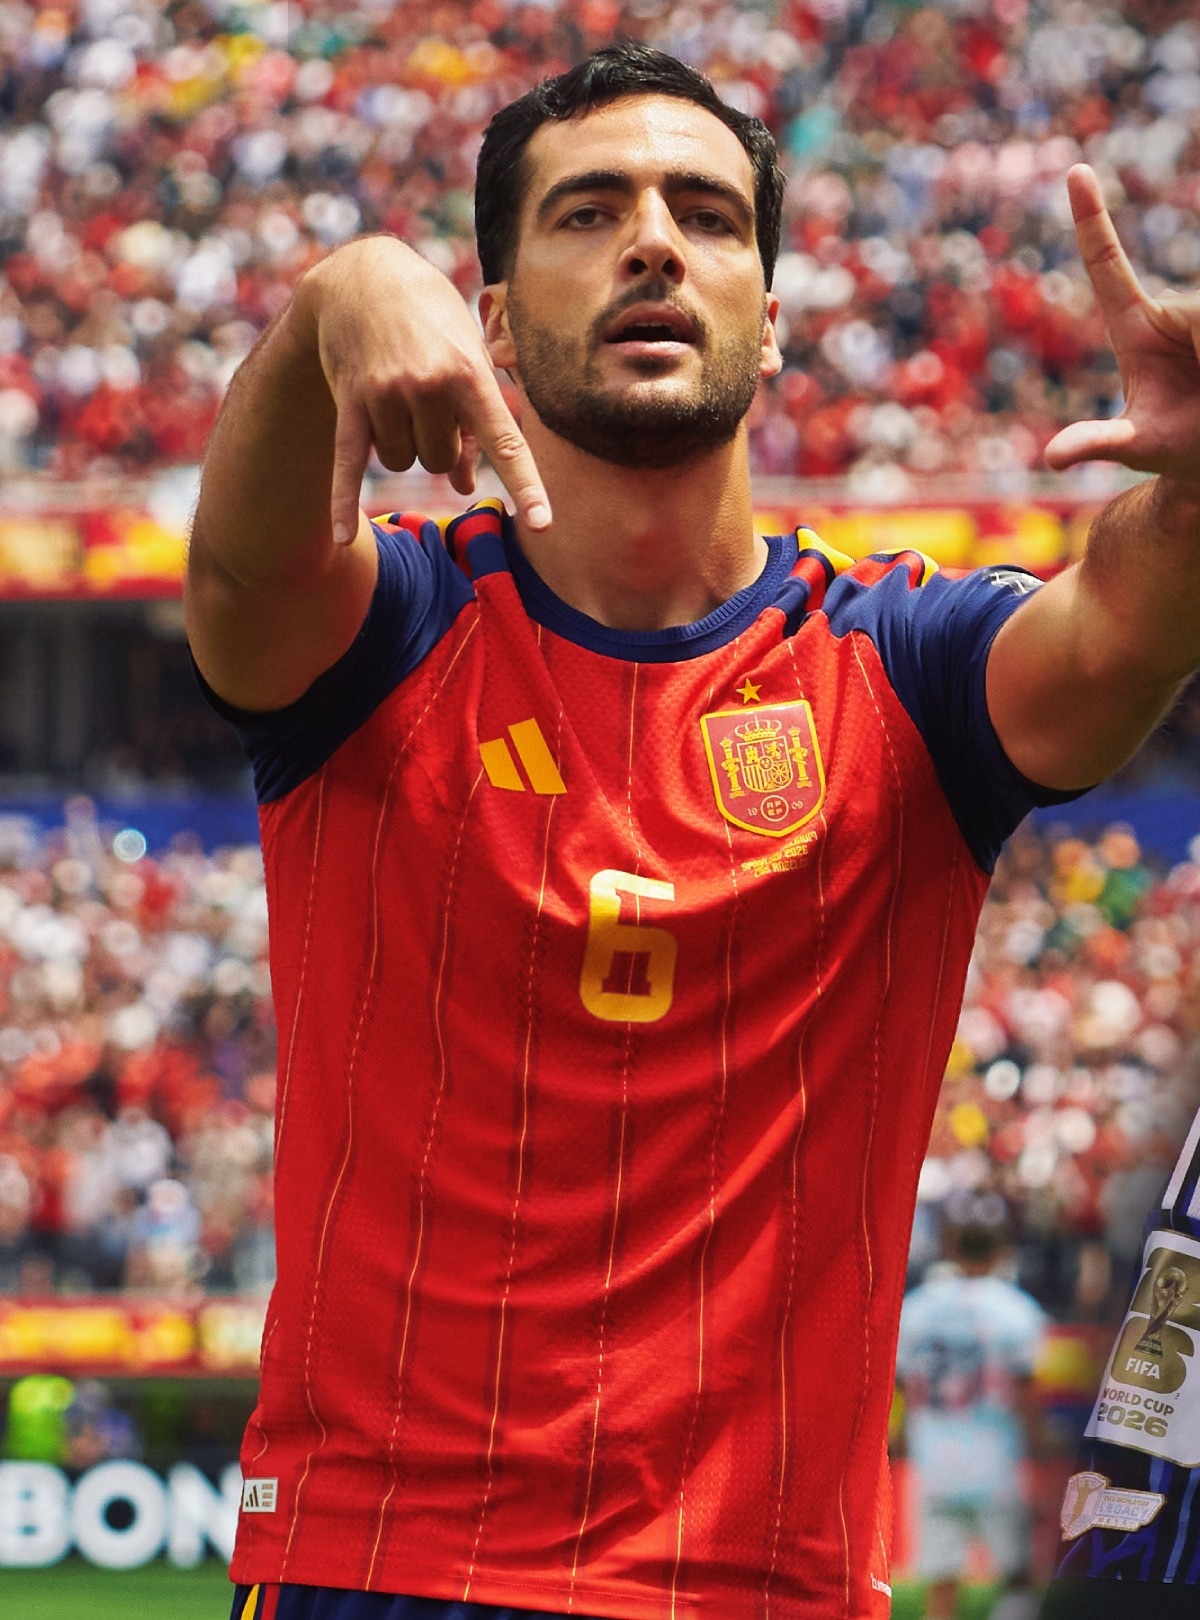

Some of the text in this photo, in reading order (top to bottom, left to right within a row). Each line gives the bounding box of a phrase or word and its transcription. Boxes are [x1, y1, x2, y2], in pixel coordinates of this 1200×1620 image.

[579, 868, 678, 1023] 6
[1125, 1357, 1160, 1380] FIFA
[1143, 1397, 1175, 1416] CUP
